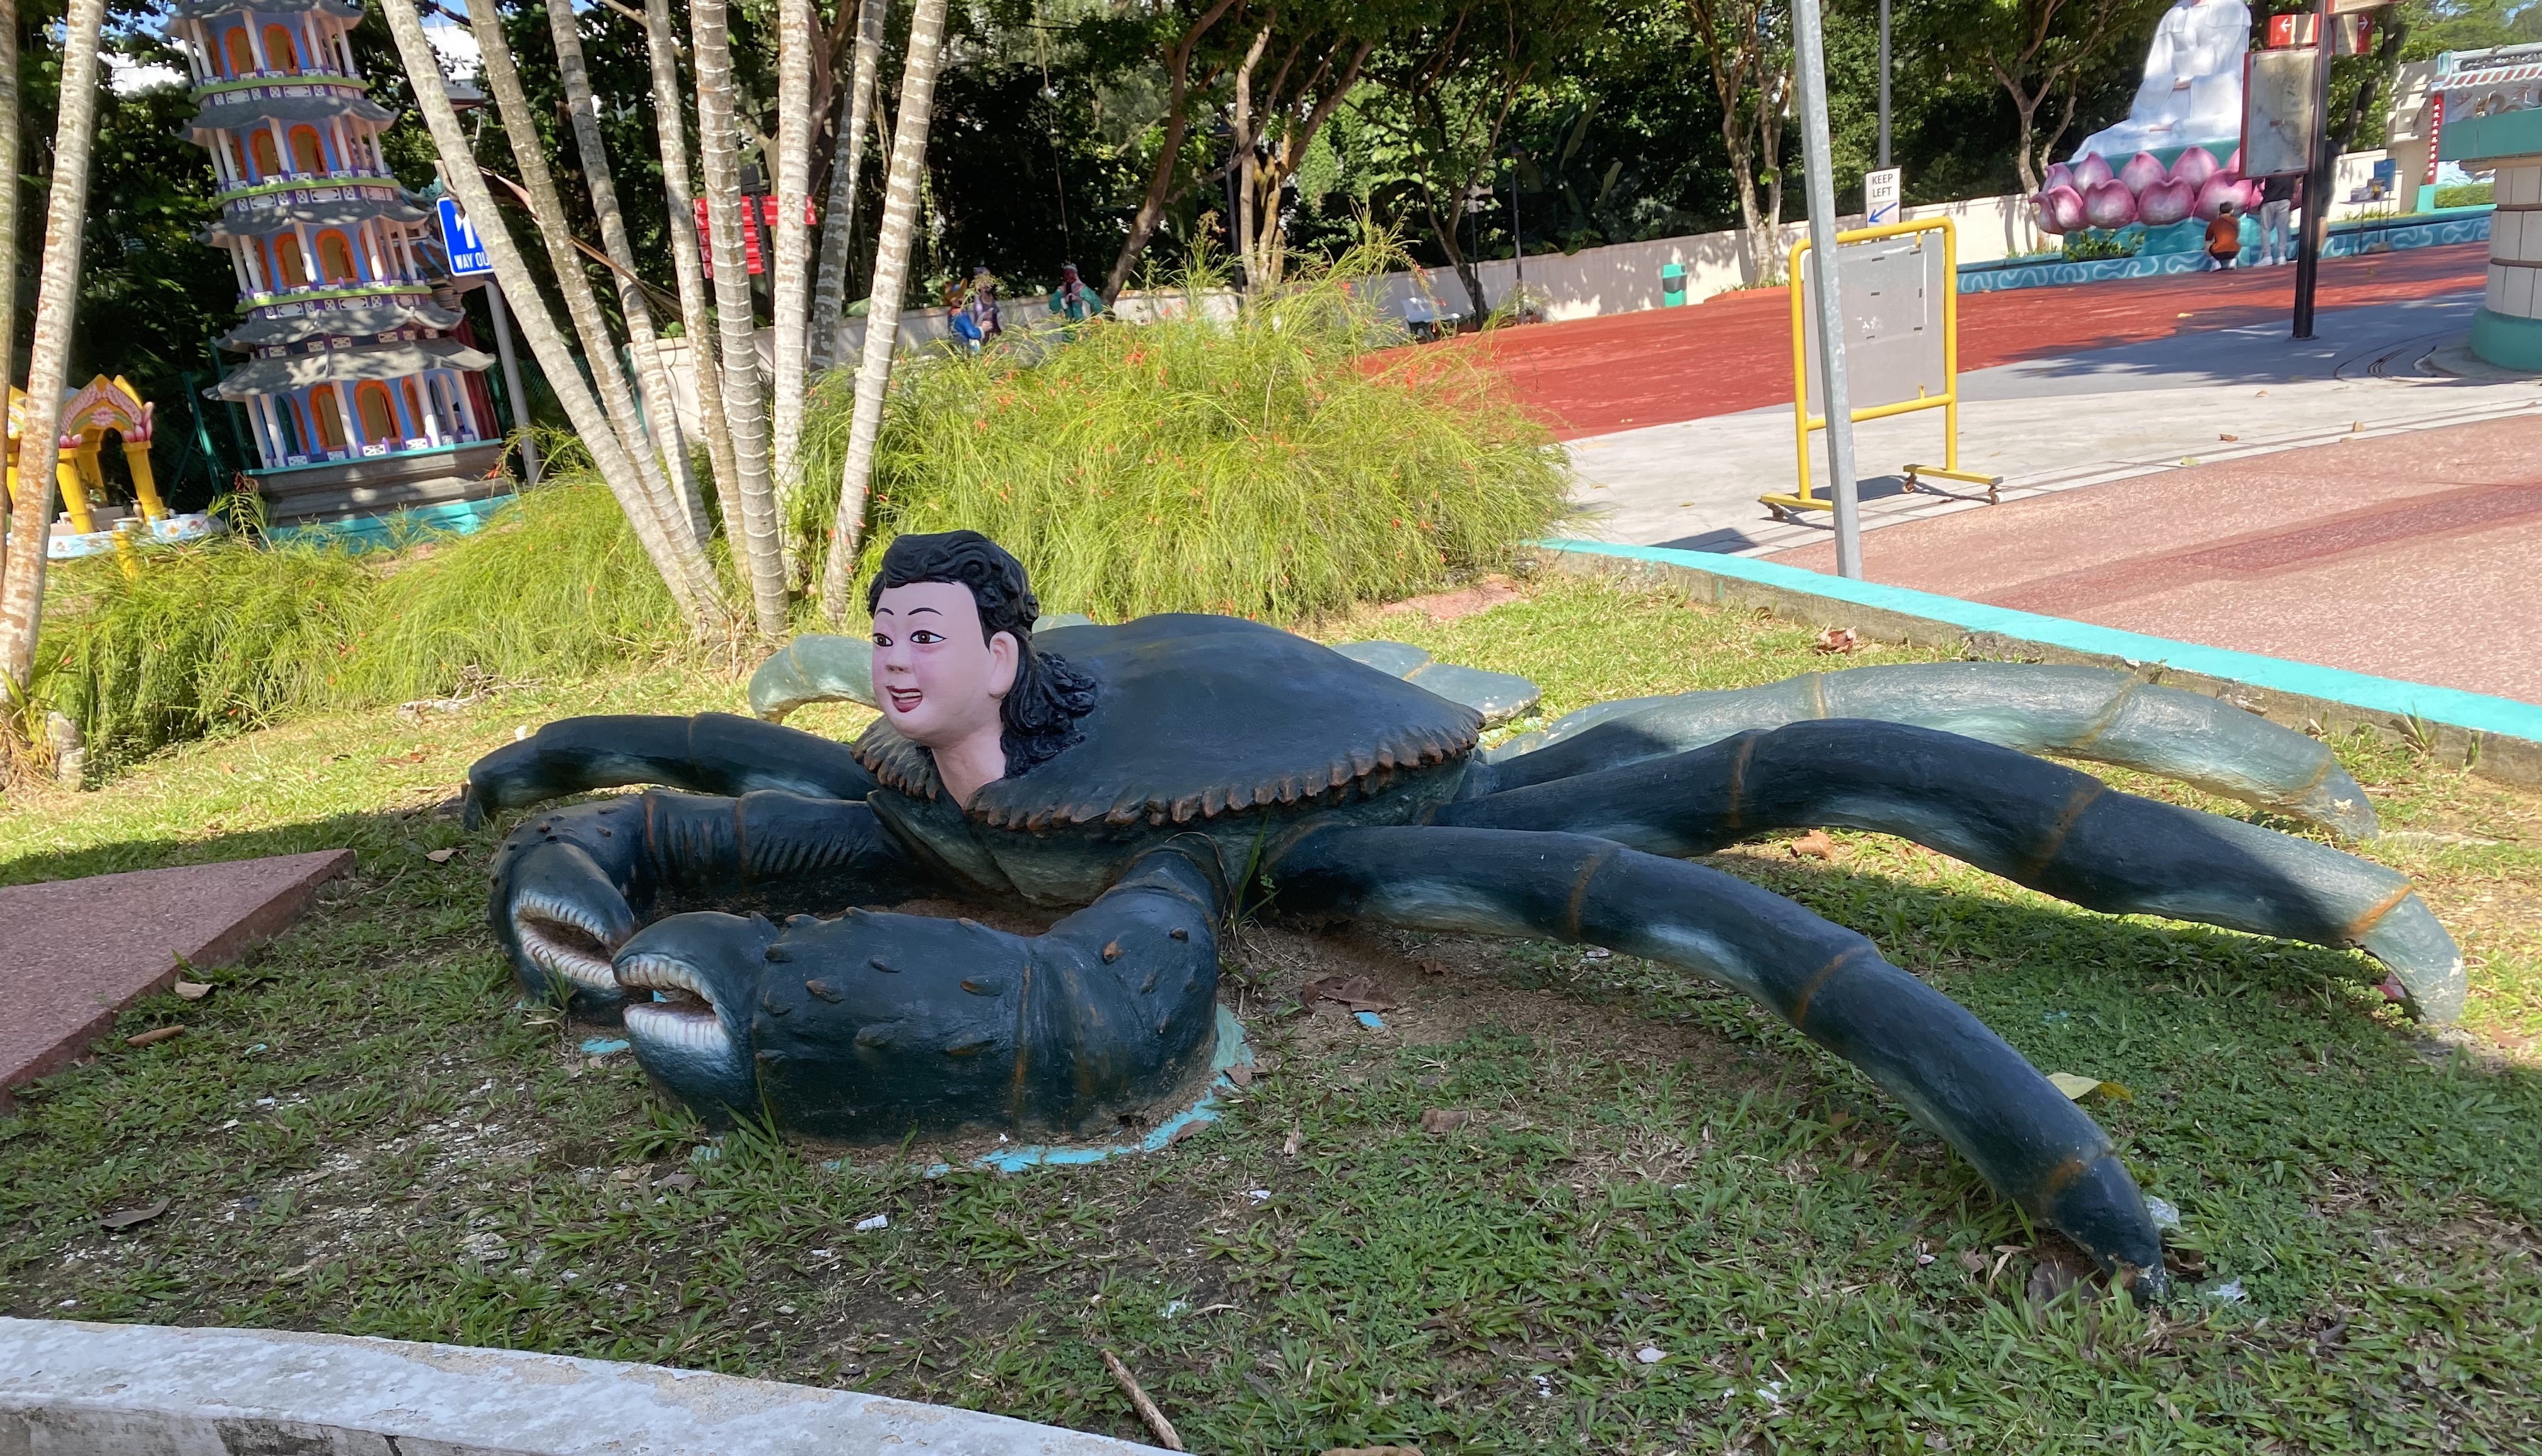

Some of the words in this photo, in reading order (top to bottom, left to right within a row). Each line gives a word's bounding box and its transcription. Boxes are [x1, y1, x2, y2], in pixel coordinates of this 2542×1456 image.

[1872, 173, 1893, 185] KEEP
[1872, 187, 1892, 198] LEFT
[454, 253, 474, 270] WAY
[475, 252, 490, 267] OU
